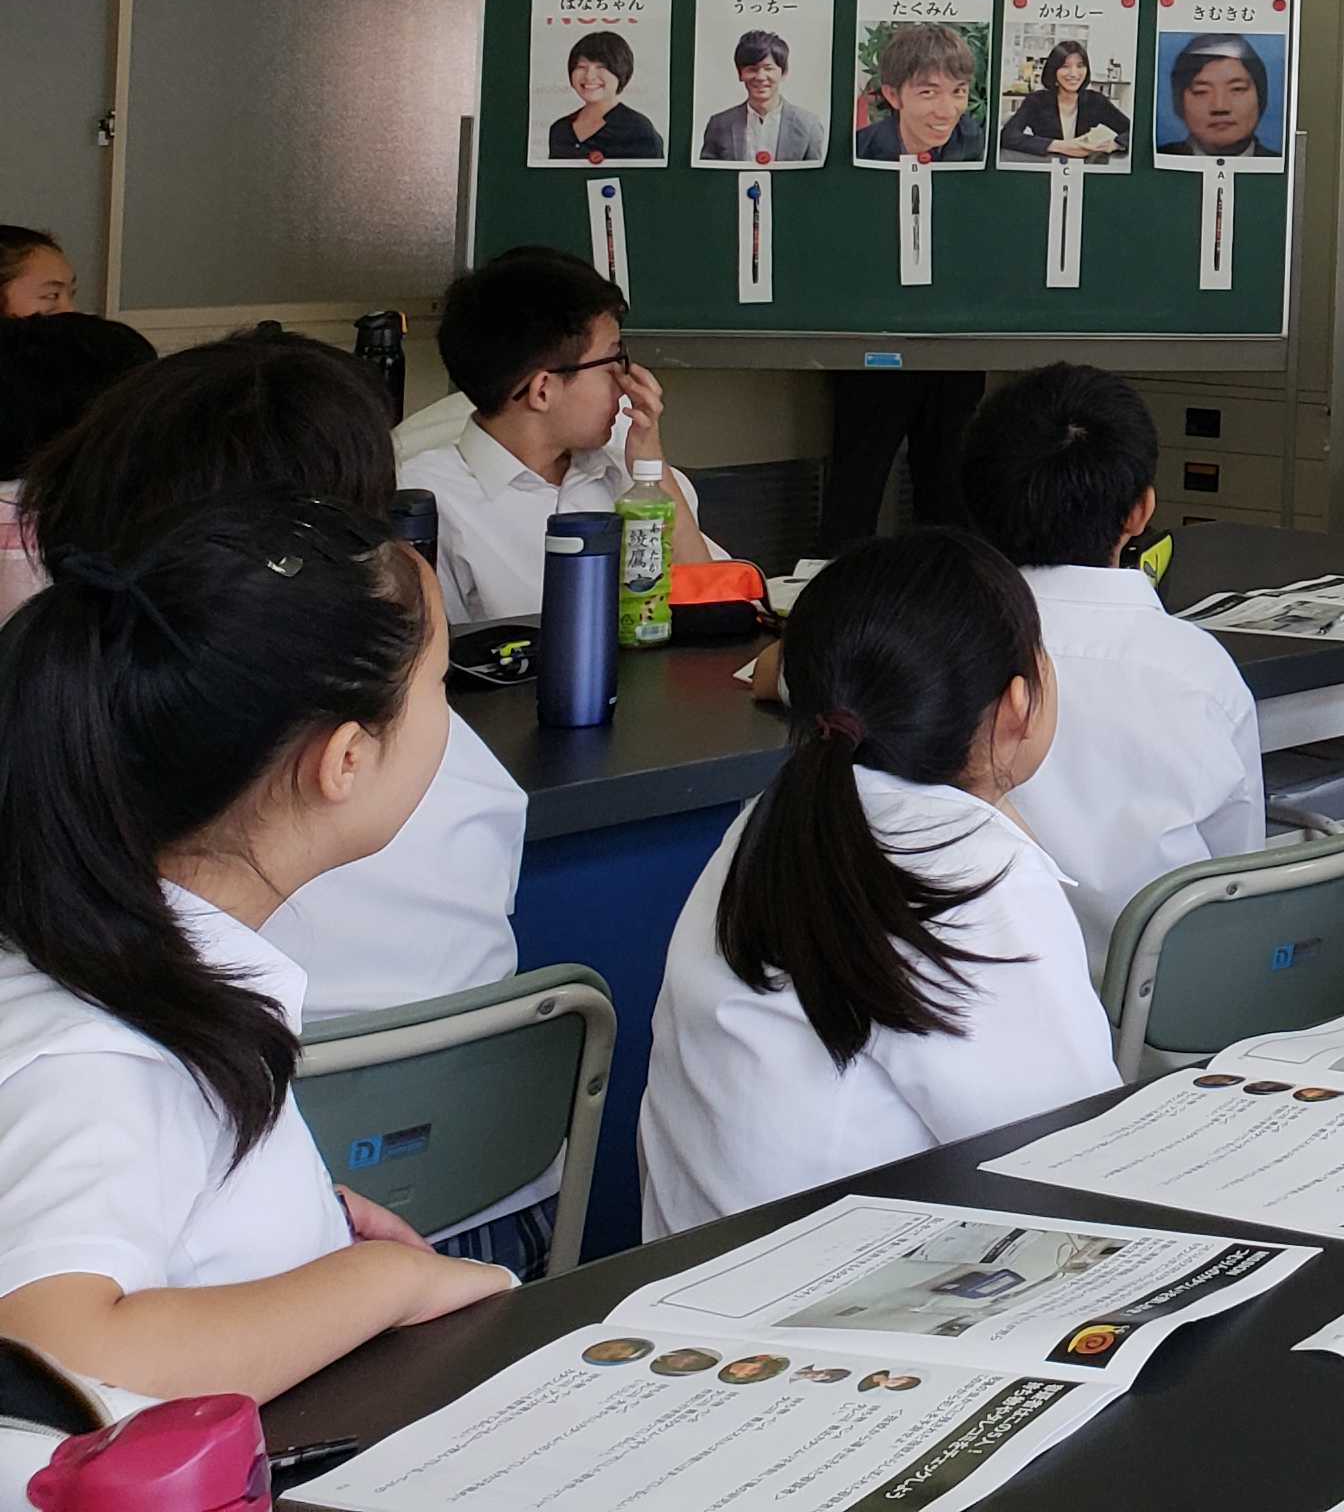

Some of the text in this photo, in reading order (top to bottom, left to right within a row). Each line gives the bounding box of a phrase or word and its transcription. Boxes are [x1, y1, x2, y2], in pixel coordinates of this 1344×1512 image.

[891, 0, 959, 17] たくみん
[1037, 2, 1105, 20] かわしー
[1192, 4, 1257, 22] きむきむ
